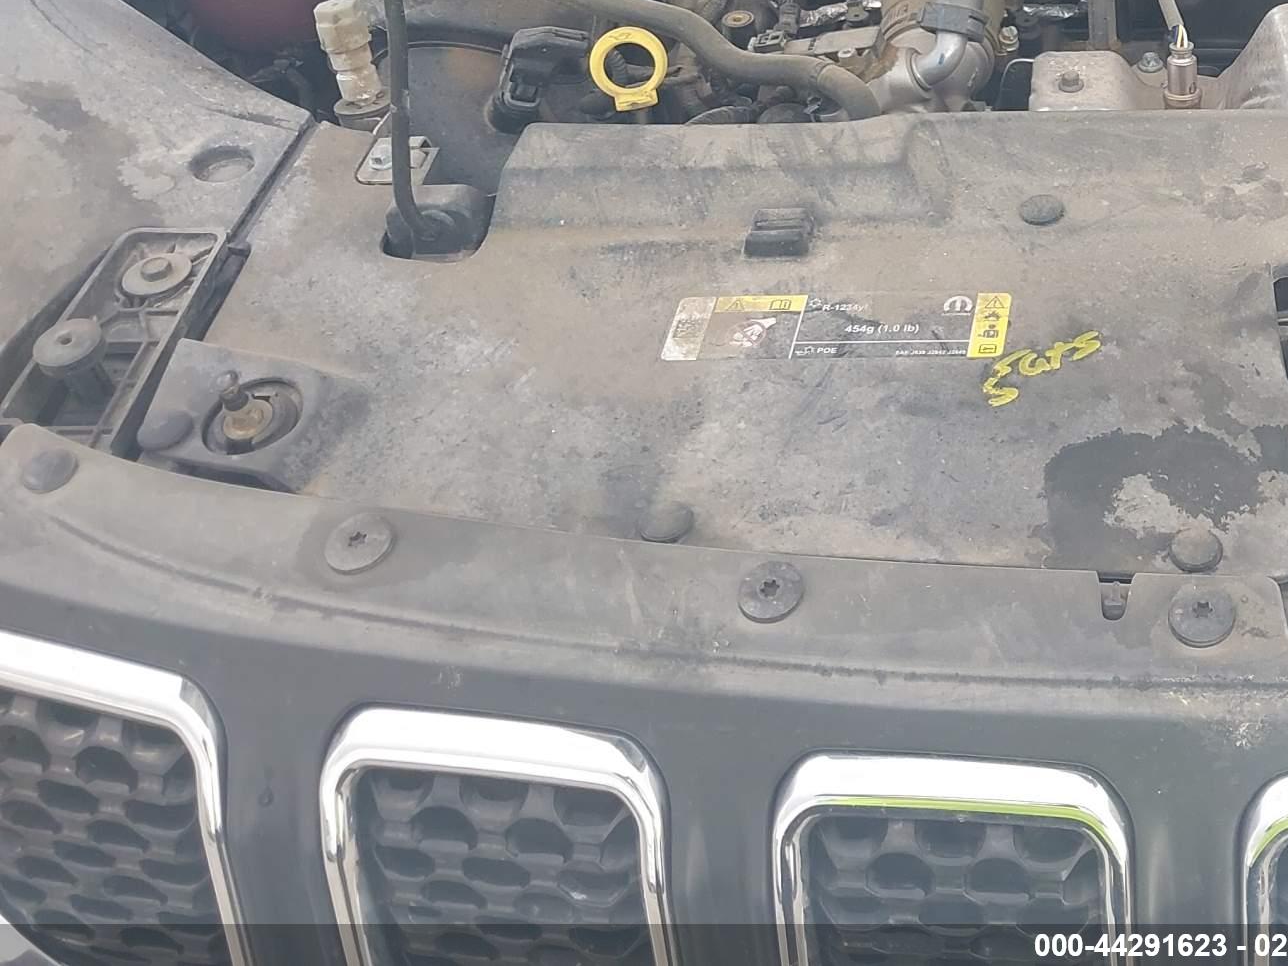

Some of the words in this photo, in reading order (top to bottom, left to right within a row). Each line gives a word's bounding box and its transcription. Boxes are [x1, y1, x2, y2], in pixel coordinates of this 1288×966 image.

[844, 324, 876, 334] 454g
[877, 323, 901, 334] (1.0
[903, 323, 921, 334] lb)
